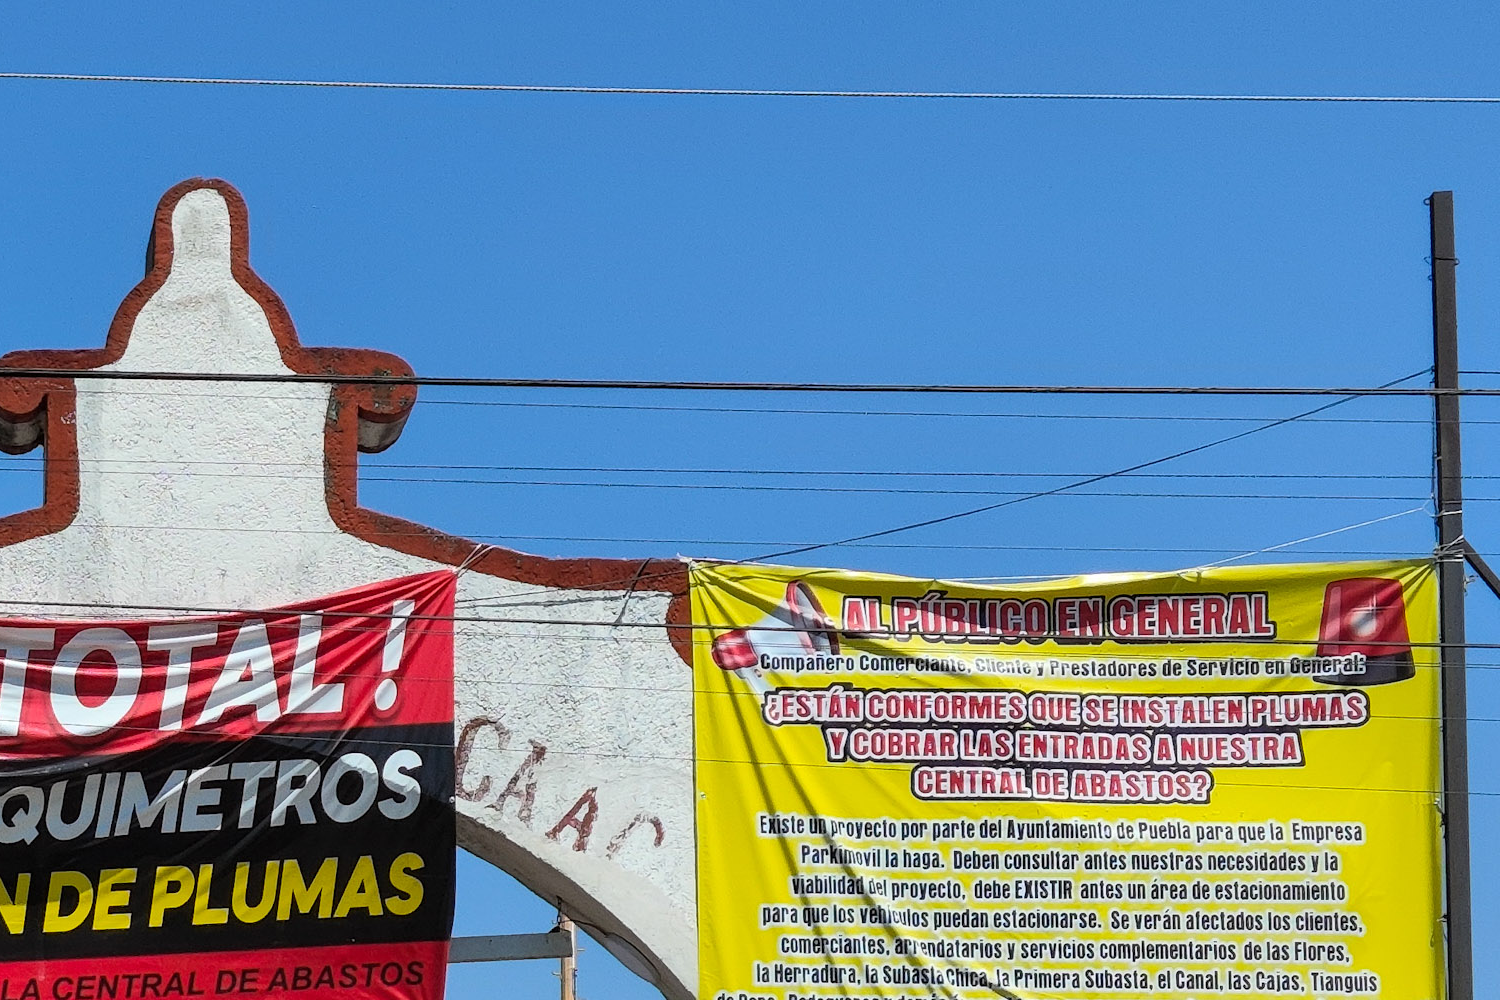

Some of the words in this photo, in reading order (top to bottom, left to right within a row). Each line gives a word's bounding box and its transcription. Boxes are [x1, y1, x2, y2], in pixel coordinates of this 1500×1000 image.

[844, 597, 890, 637] AL
[893, 591, 1048, 639] PÚBLICO
[1056, 599, 1103, 638] EN
[1110, 595, 1274, 639] GENERAL
[760, 653, 854, 672] Compañero
[859, 655, 971, 674] Comerciante,
[976, 658, 1031, 674] Cliente
[1037, 662, 1044, 676] y
[1050, 658, 1158, 677] Prestadores
[1163, 660, 1181, 676] de
[1187, 659, 1259, 676] Servicio
[1266, 663, 1286, 675] en
[1291, 654, 1366, 675] General:
[767, 688, 861, 722] ¿ESTÁN
[867, 694, 1025, 722] CONFORMES
[1030, 696, 1079, 725] QUE
[1083, 698, 1117, 724] SE
[1121, 698, 1247, 724] INSTALEN
[1251, 695, 1365, 725] PLUMAS
[829, 730, 847, 759] Y
[851, 731, 957, 759] COBRAR
[962, 732, 1011, 759] LAS
[1016, 734, 1150, 762] ENTRADAS
[1155, 736, 1175, 762] A
[1178, 735, 1302, 762] NUESTRA
[915, 767, 1028, 797] CENTRAL
[1034, 769, 1067, 797] DE
[1073, 771, 1210, 799] ABASTOS?
[760, 816, 804, 834] Existe
[810, 818, 826, 834] un
[831, 818, 897, 838] proyecto
[901, 821, 927, 841] por
[932, 821, 975, 842] parte
[980, 819, 1002, 839] del
[1007, 819, 1112, 840] Ayuntamiento
[1117, 823, 1134, 840] de
[1139, 822, 1190, 840] Puebla
[1197, 825, 1233, 843] para
[1238, 826, 1266, 843] que
[1270, 822, 1283, 841] la
[1292, 823, 1363, 843] Empresa
[44, 867, 137, 933] DE
[150, 852, 424, 927] PLUMAS
[53, 971, 204, 1000] CENTRAL
[216, 969, 258, 994] DE
[270, 961, 424, 991] ABASTOS
